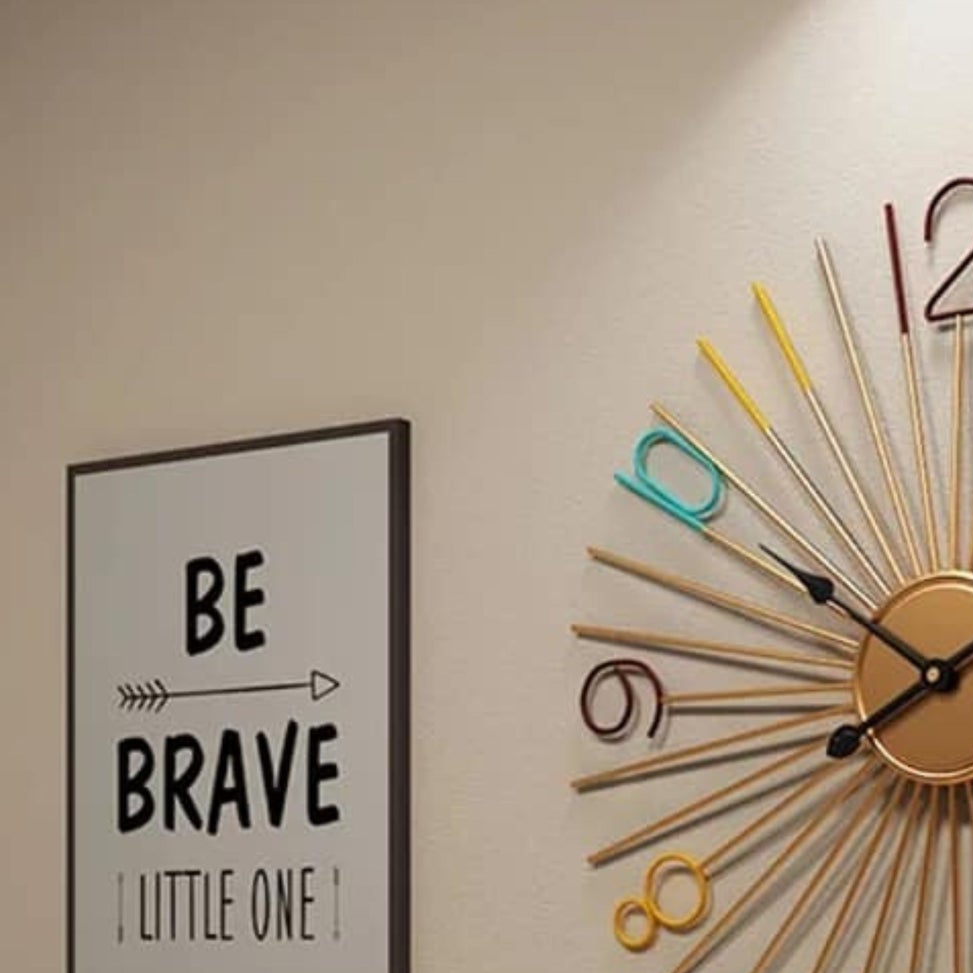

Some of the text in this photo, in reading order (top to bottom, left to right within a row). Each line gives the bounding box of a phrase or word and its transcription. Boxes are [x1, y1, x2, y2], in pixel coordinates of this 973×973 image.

[185, 549, 266, 657] BE
[117, 718, 340, 836] BRAVE
[139, 866, 315, 942] LITTLE ONE
[613, 852, 711, 952] 8
